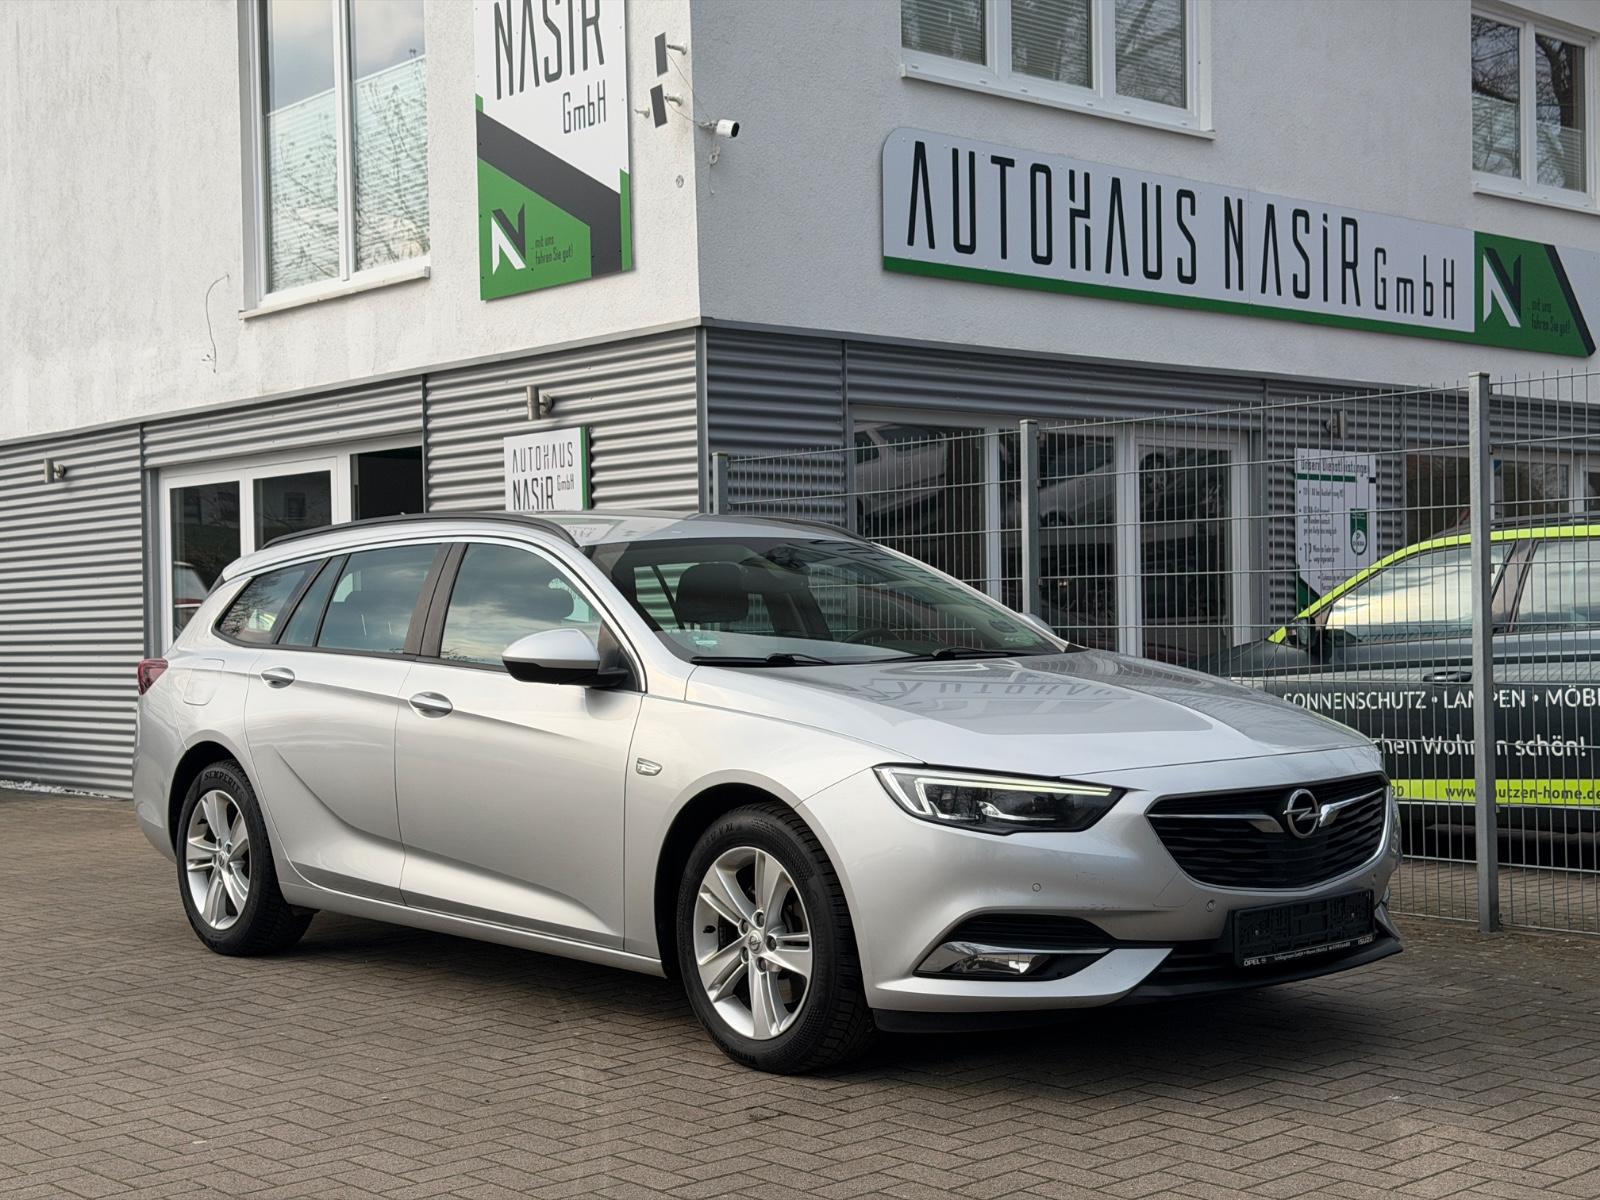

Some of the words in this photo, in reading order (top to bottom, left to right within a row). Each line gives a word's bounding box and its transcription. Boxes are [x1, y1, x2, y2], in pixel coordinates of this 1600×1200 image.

[562, 79, 607, 134] GmbH
[907, 140, 1197, 285] AUTOHAUS
[1374, 247, 1455, 320] GmbH
[512, 441, 574, 474] AUTOHAUS
[556, 473, 575, 492] GmbH
[1545, 684, 1600, 707] MÖB
[1515, 734, 1586, 757] schön!
[1243, 958, 1261, 967] OPEL
